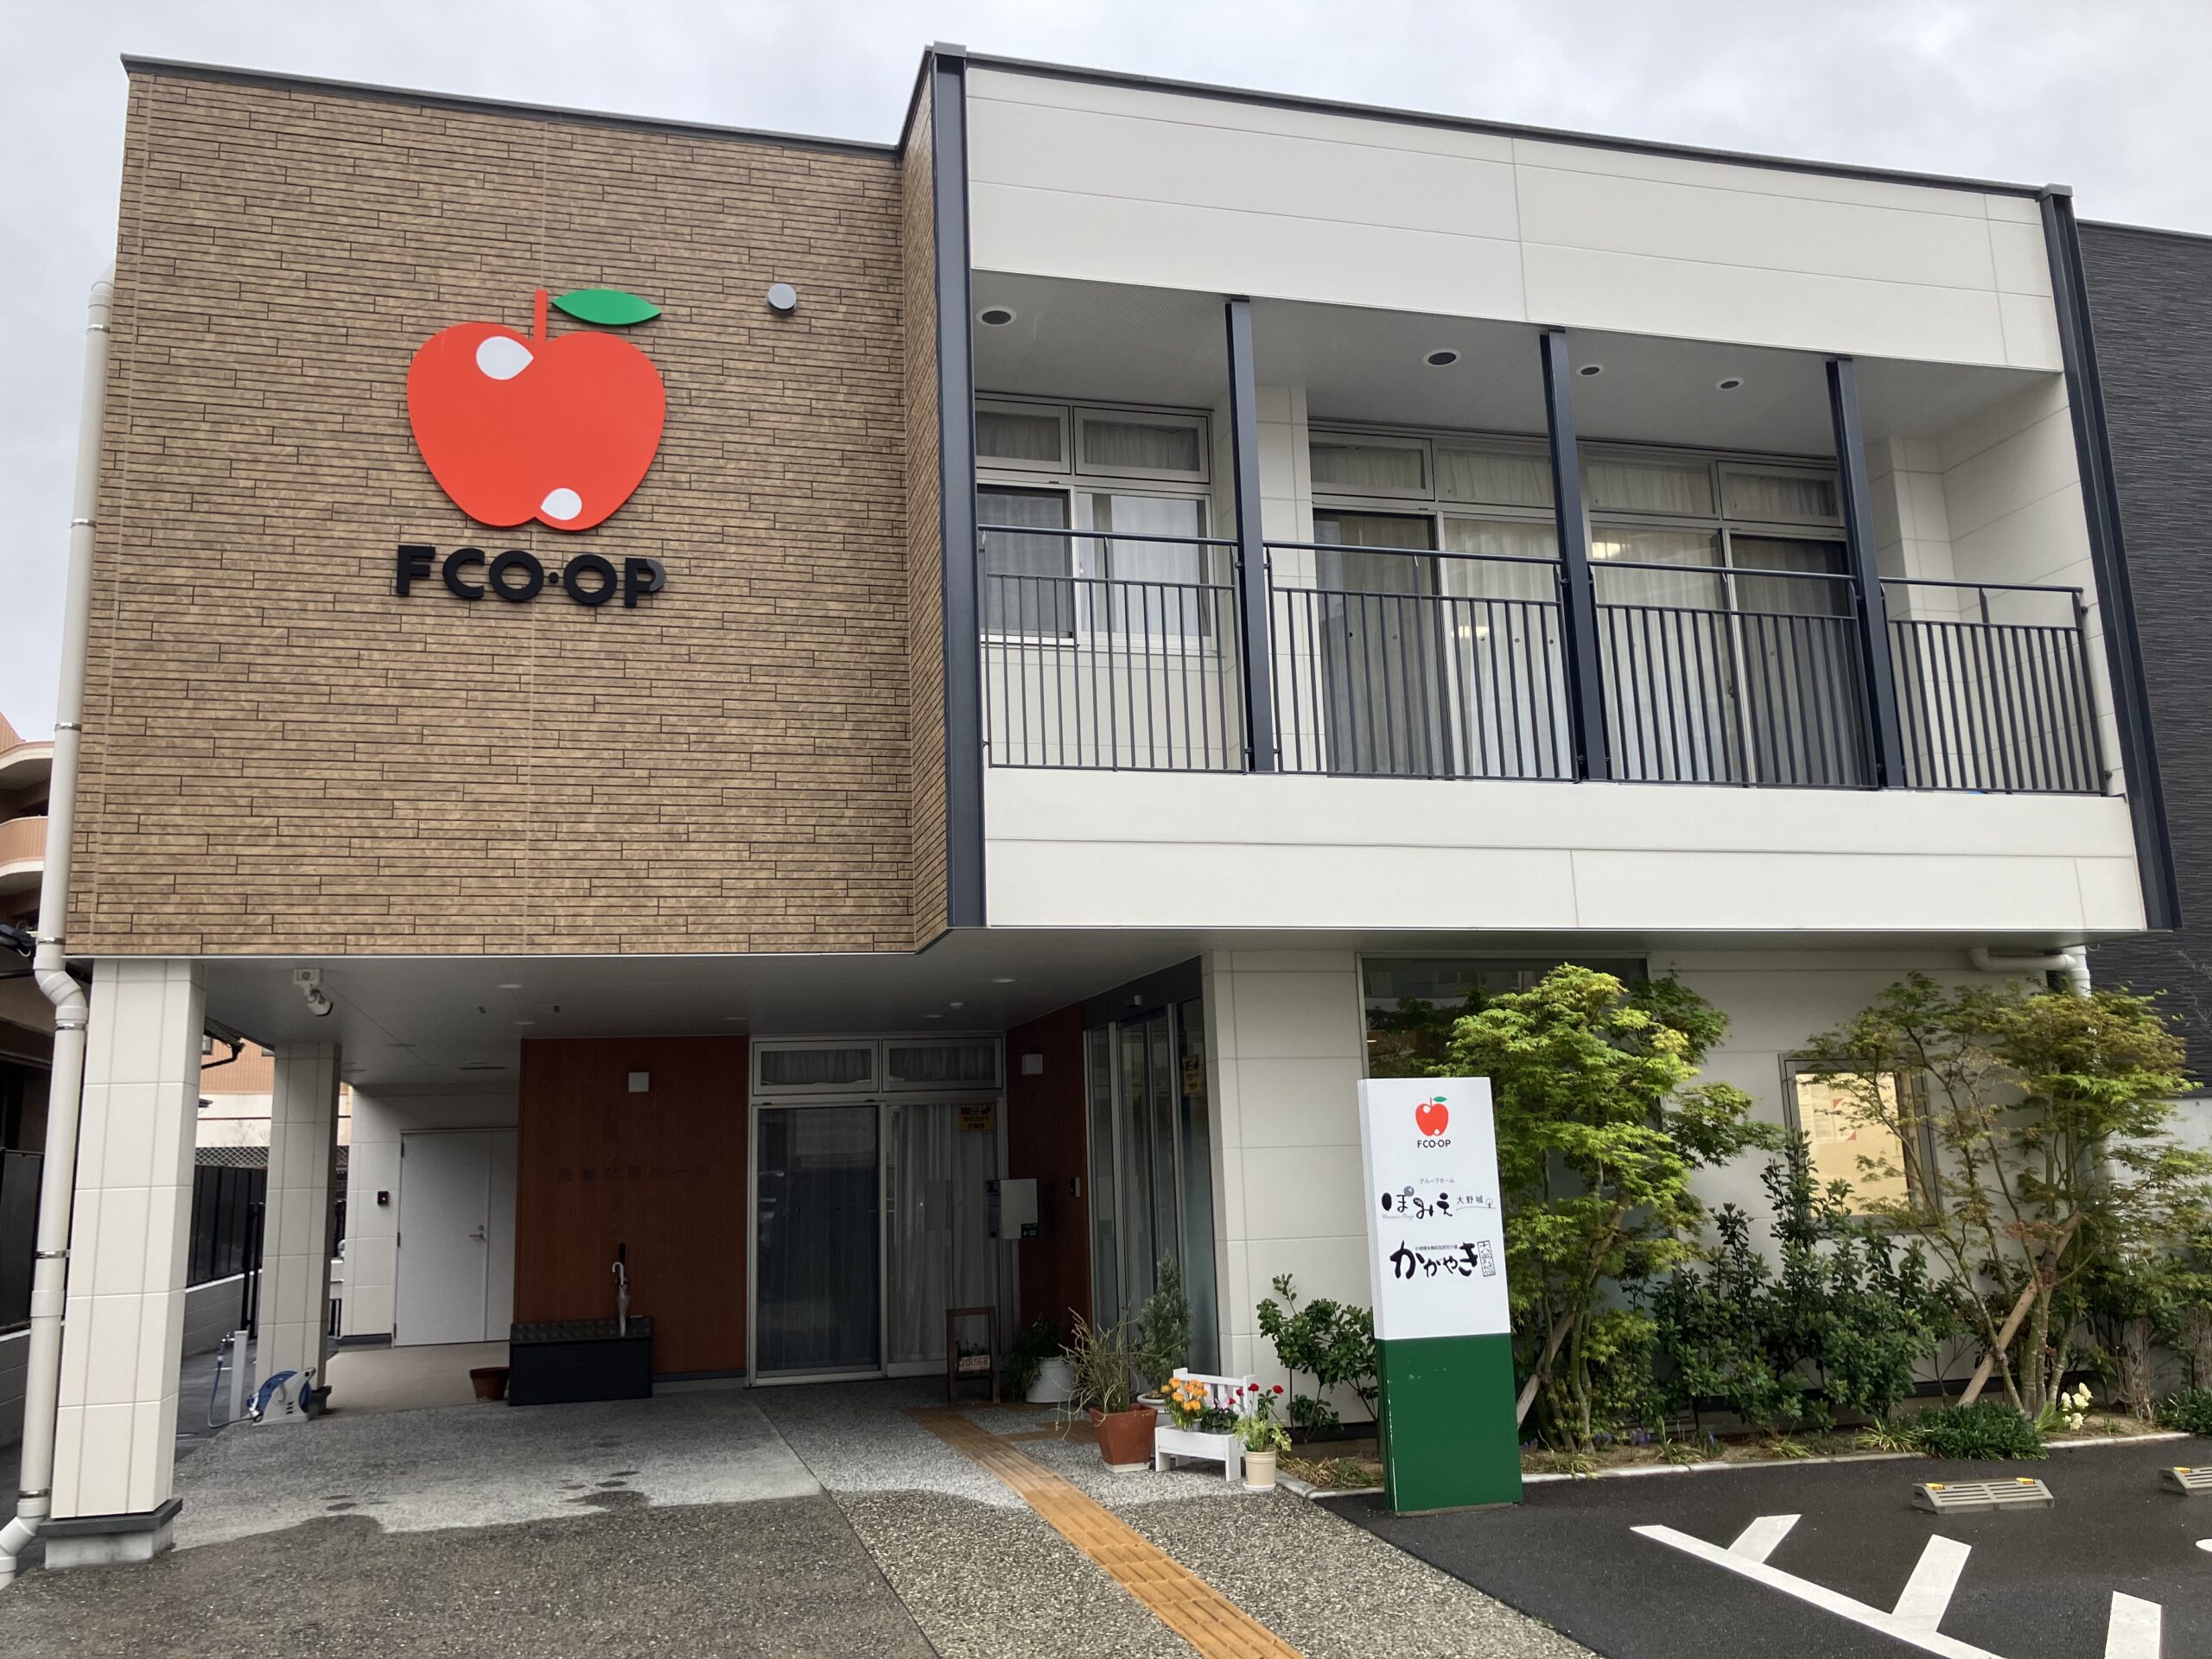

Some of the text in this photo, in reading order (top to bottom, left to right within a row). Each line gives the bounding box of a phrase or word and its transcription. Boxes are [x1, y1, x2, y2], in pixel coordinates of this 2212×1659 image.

[1457, 1195, 1484, 1205] 大野城
[1389, 1240, 1478, 1280] かがやき
